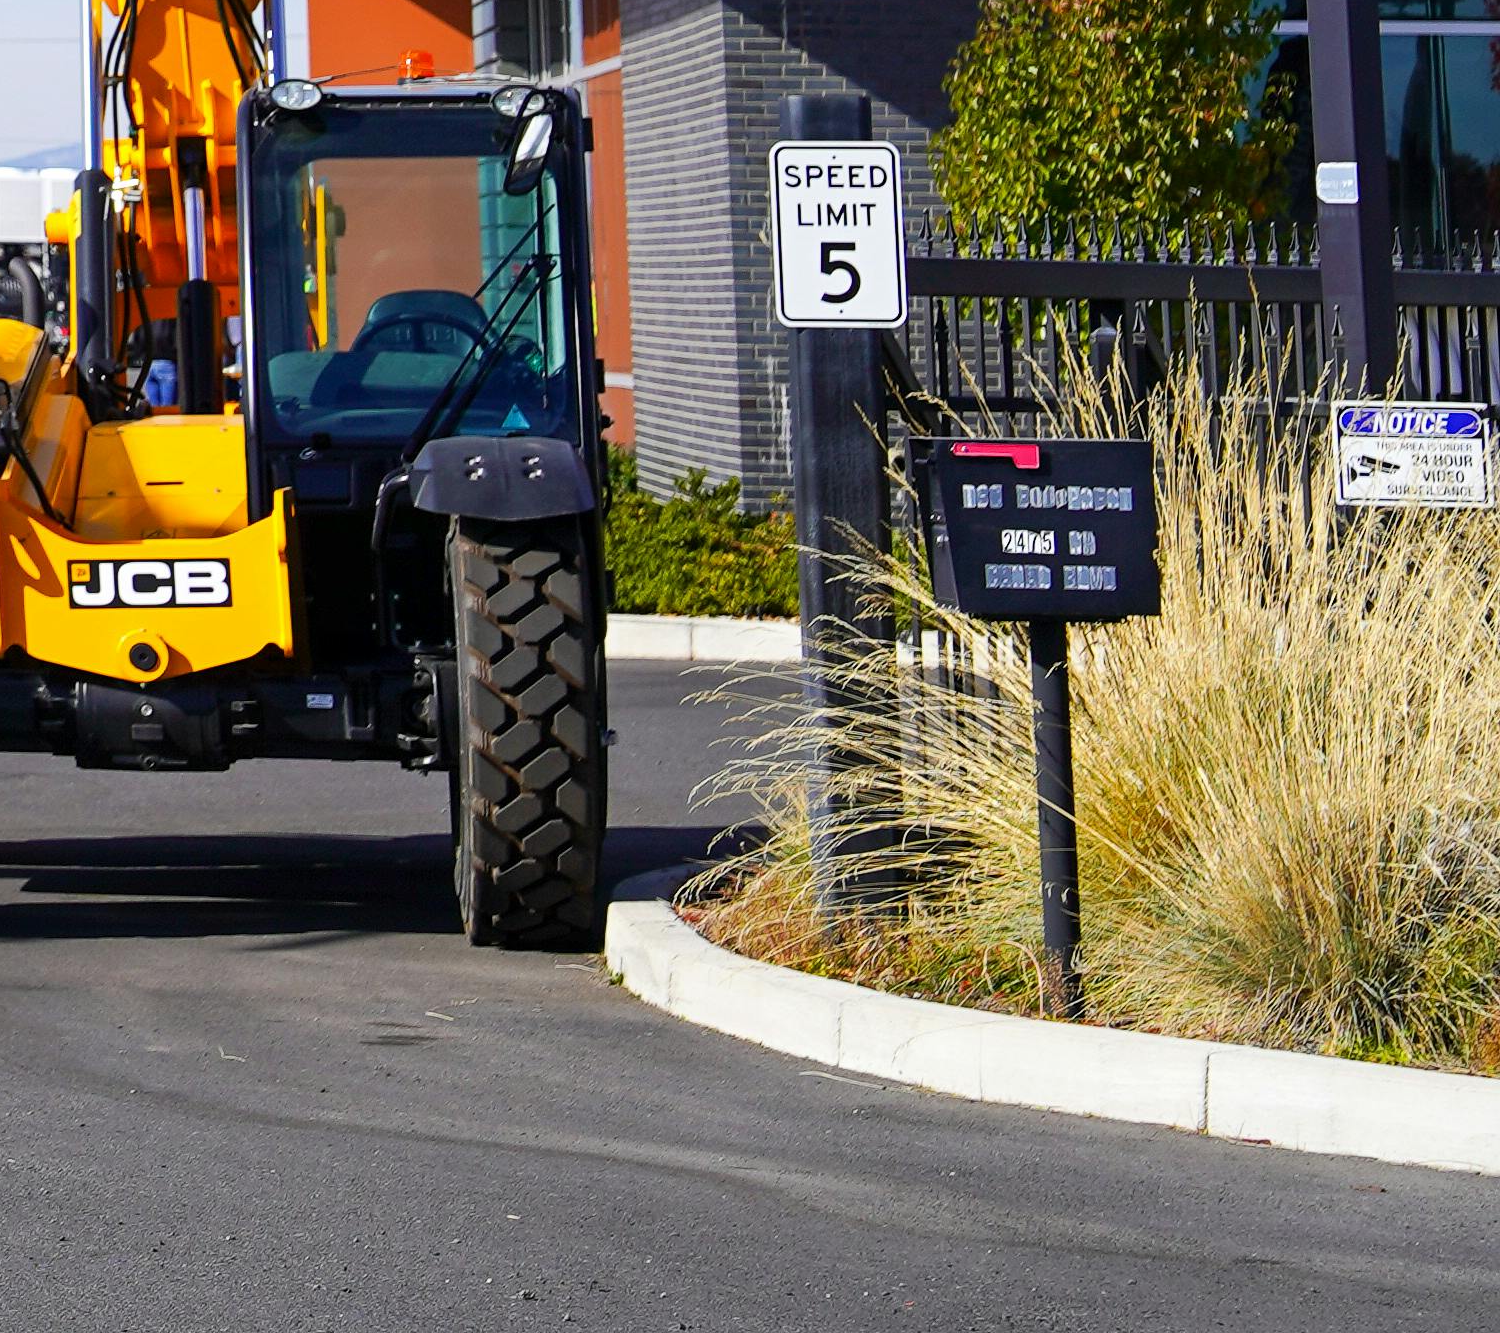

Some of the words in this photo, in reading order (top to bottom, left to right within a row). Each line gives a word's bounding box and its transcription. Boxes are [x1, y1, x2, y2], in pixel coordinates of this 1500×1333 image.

[784, 165, 888, 189] SPEED
[797, 203, 877, 227] LIMIT
[820, 241, 862, 304] 5
[1373, 410, 1449, 434] NOTICE
[1002, 531, 1054, 554] 2475
[71, 561, 229, 606] JCB
